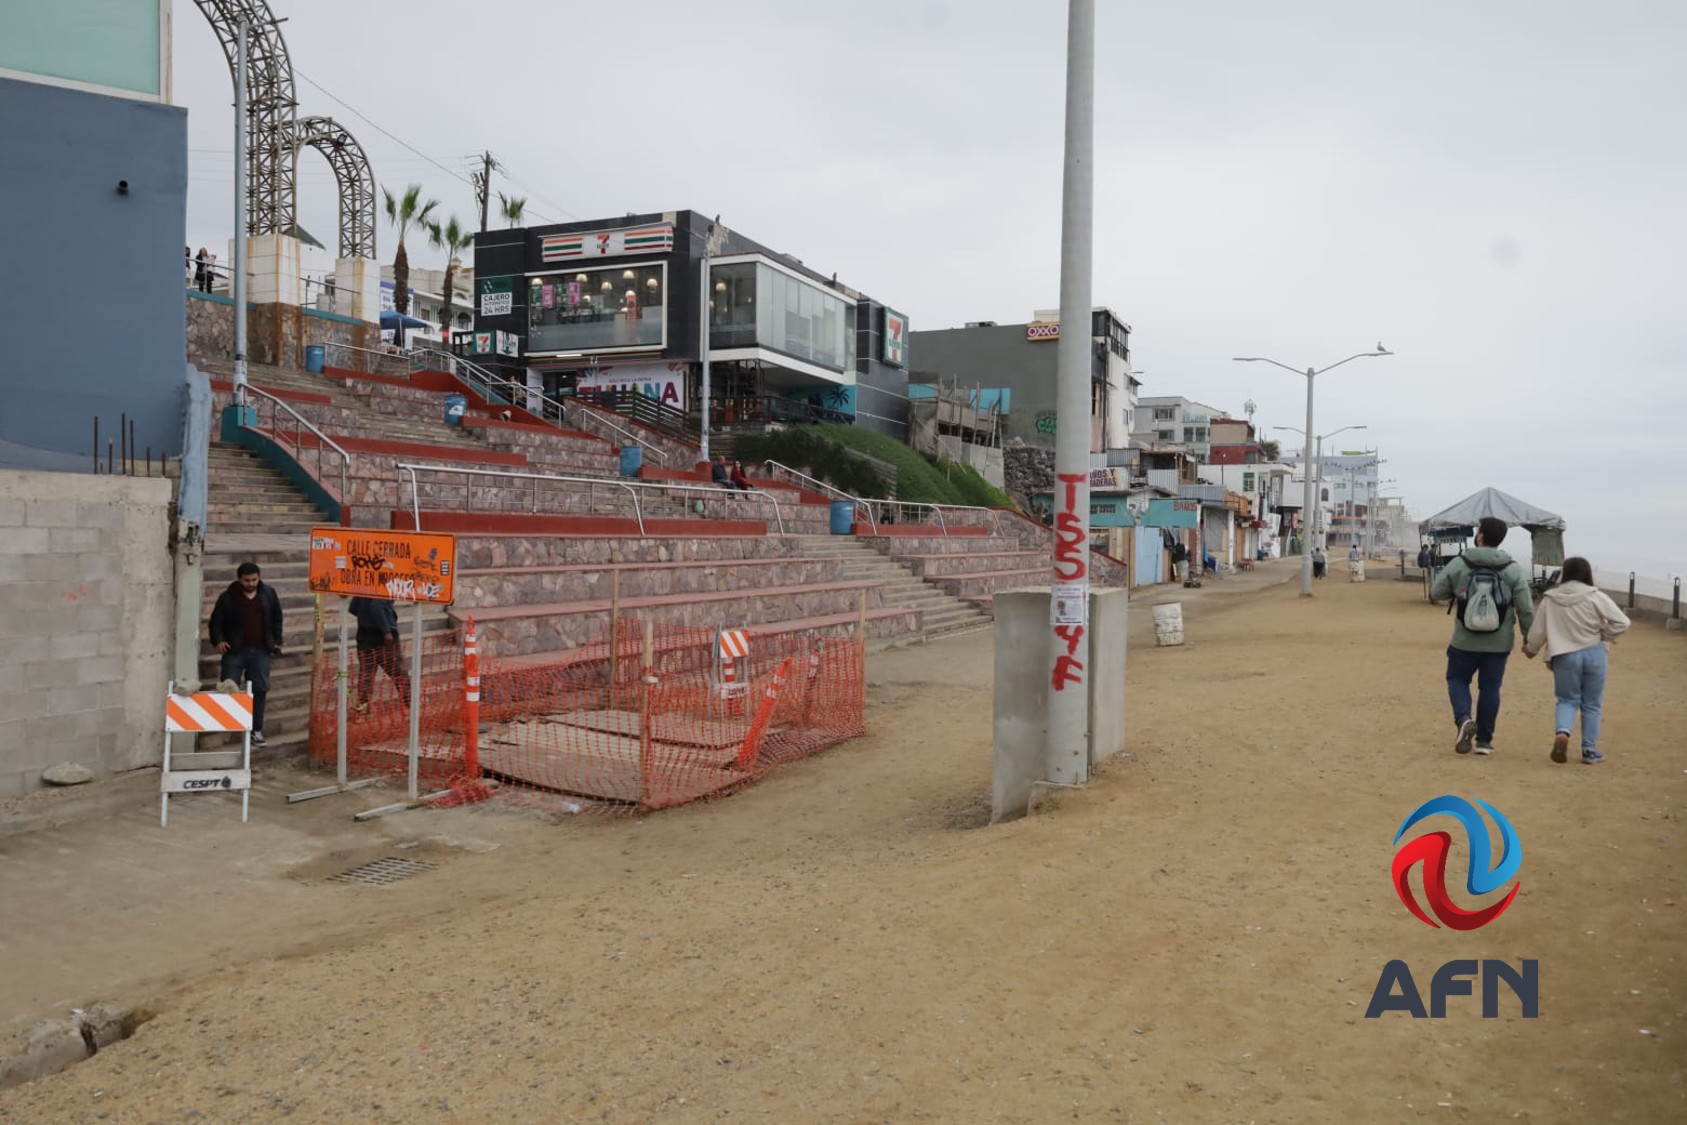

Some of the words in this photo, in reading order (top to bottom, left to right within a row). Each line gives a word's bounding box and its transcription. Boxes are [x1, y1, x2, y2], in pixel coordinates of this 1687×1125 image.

[484, 293, 510, 302] CAJERO
[1027, 325, 1060, 338] OXXO
[346, 539, 370, 556] CALLE
[373, 541, 411, 559] CERRADA
[340, 568, 361, 586] OBRA
[364, 570, 375, 587] EN
[183, 779, 221, 789] CESPT
